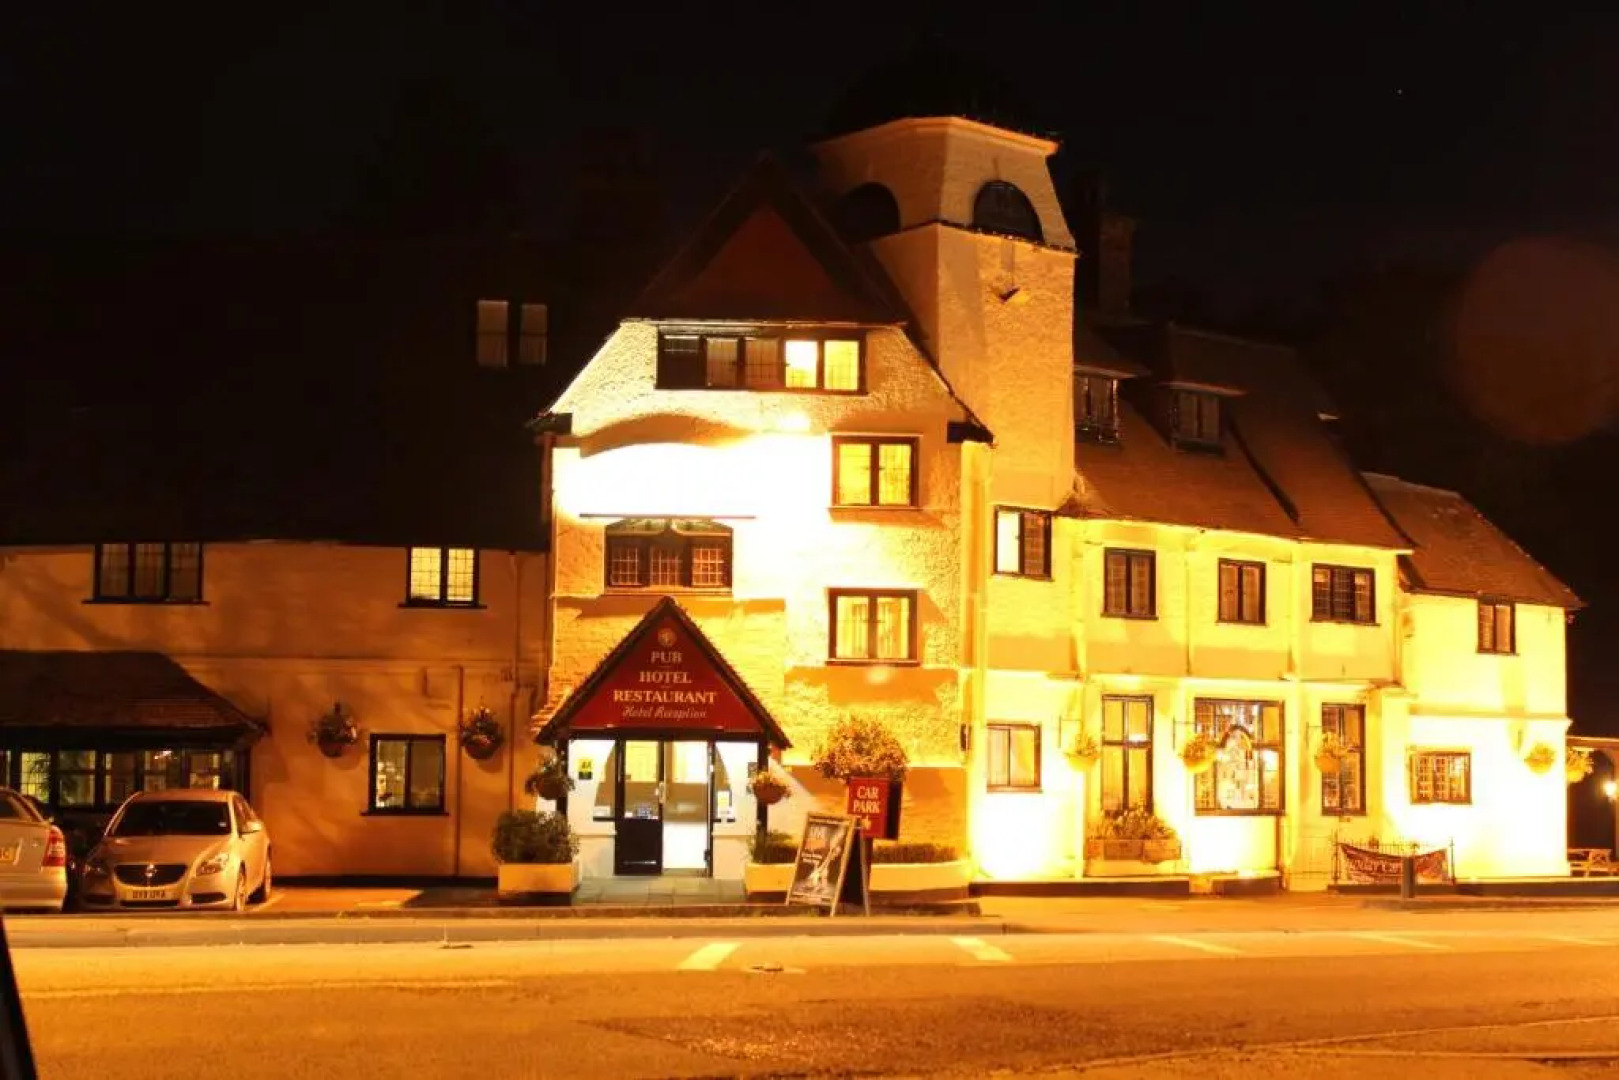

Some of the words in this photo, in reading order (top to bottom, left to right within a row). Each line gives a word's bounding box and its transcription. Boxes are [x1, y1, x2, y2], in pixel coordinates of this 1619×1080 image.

[650, 651, 682, 664] PUB
[638, 671, 692, 684] HOTEL
[613, 690, 717, 705] RESTAURANT
[622, 705, 652, 719] Hotel
[654, 705, 707, 722] Reception
[856, 785, 880, 799] CAR
[853, 801, 880, 814] PARK
